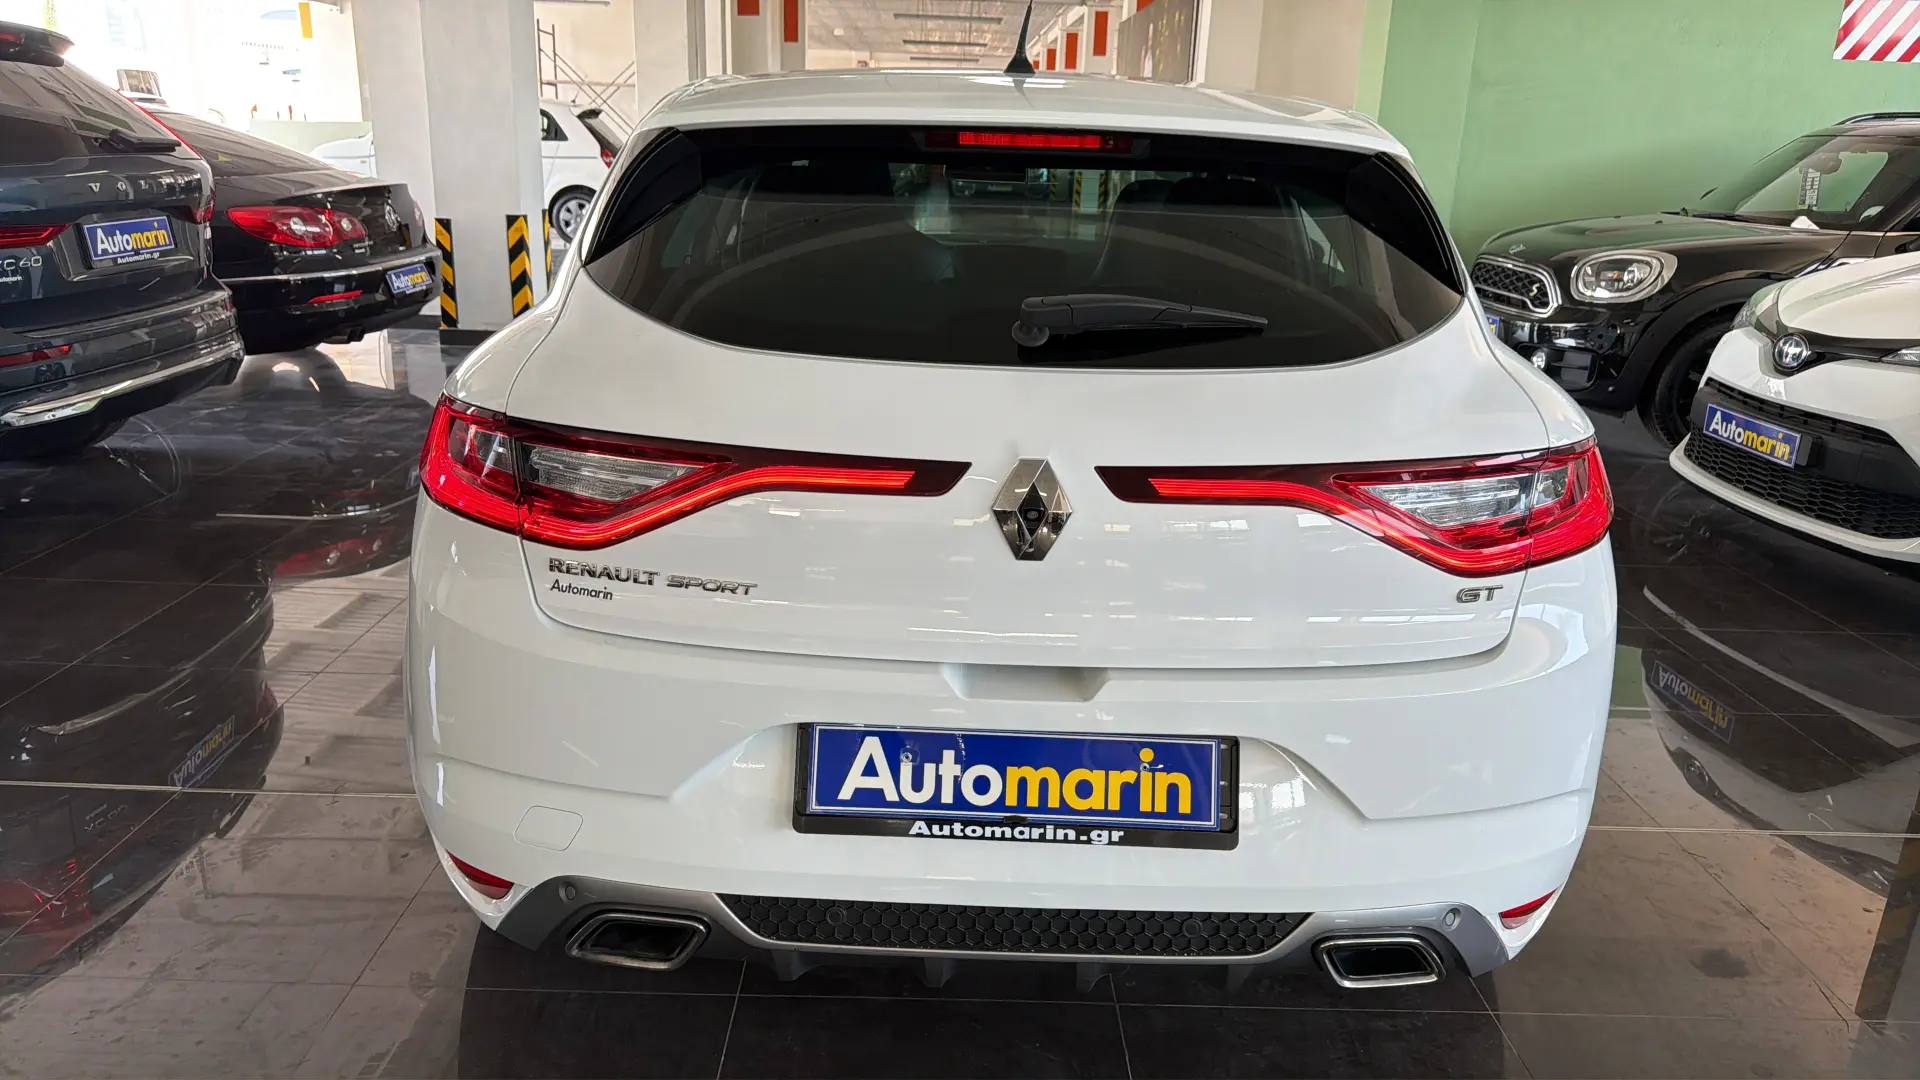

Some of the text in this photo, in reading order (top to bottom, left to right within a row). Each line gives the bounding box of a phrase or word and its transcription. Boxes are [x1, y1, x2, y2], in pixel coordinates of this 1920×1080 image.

[97, 221, 170, 255] Automarin
[0, 256, 43, 271] C60
[391, 267, 429, 290] Automarin
[1709, 410, 1791, 461] Automarin
[548, 557, 759, 596] RENAULT SPORT
[550, 578, 614, 601] Automarin
[1456, 584, 1504, 603] GT
[836, 735, 1193, 815] Automarin
[908, 820, 1125, 845] Automarin.gr
